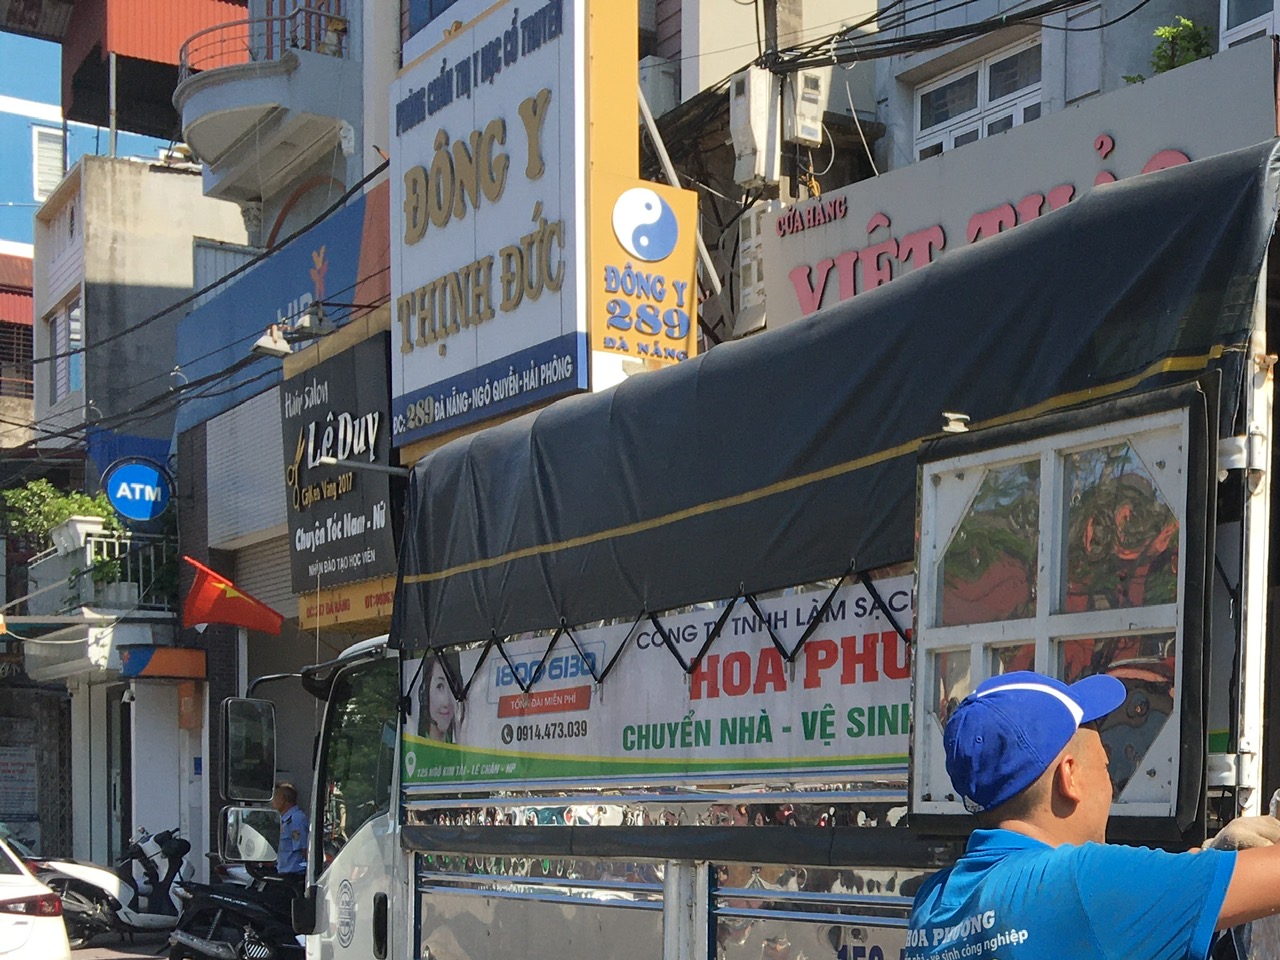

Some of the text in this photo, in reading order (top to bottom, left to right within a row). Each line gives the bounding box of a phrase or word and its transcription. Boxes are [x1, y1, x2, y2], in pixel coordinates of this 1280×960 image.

[403, 88, 552, 246] ĐÔNG Y
[806, 193, 848, 229] HÀNG
[397, 201, 566, 358] THỊNH ĐỨC
[605, 262, 688, 307] ĐÔNG Y
[606, 298, 691, 340] 289
[604, 336, 629, 352] ĐÀ
[406, 396, 434, 430] 289
[307, 411, 379, 469] Lê Duy
[116, 482, 161, 502] ATM
[338, 472, 353, 495] 2017
[295, 521, 326, 552] Chuyên
[326, 512, 342, 542] Tóc
[343, 512, 365, 538] Nam
[731, 609, 788, 636] TNHH
[795, 598, 846, 626] LÀM
[495, 651, 597, 687] 1800 6130
[689, 647, 787, 700] HOA
[516, 720, 588, 742] 0914.473.039
[622, 709, 711, 751] CHUYỂN
[720, 709, 773, 746] NHÀ
[801, 703, 836, 746] VỆ
[961, 941, 983, 956] công
[984, 928, 1029, 952] nghiệp
